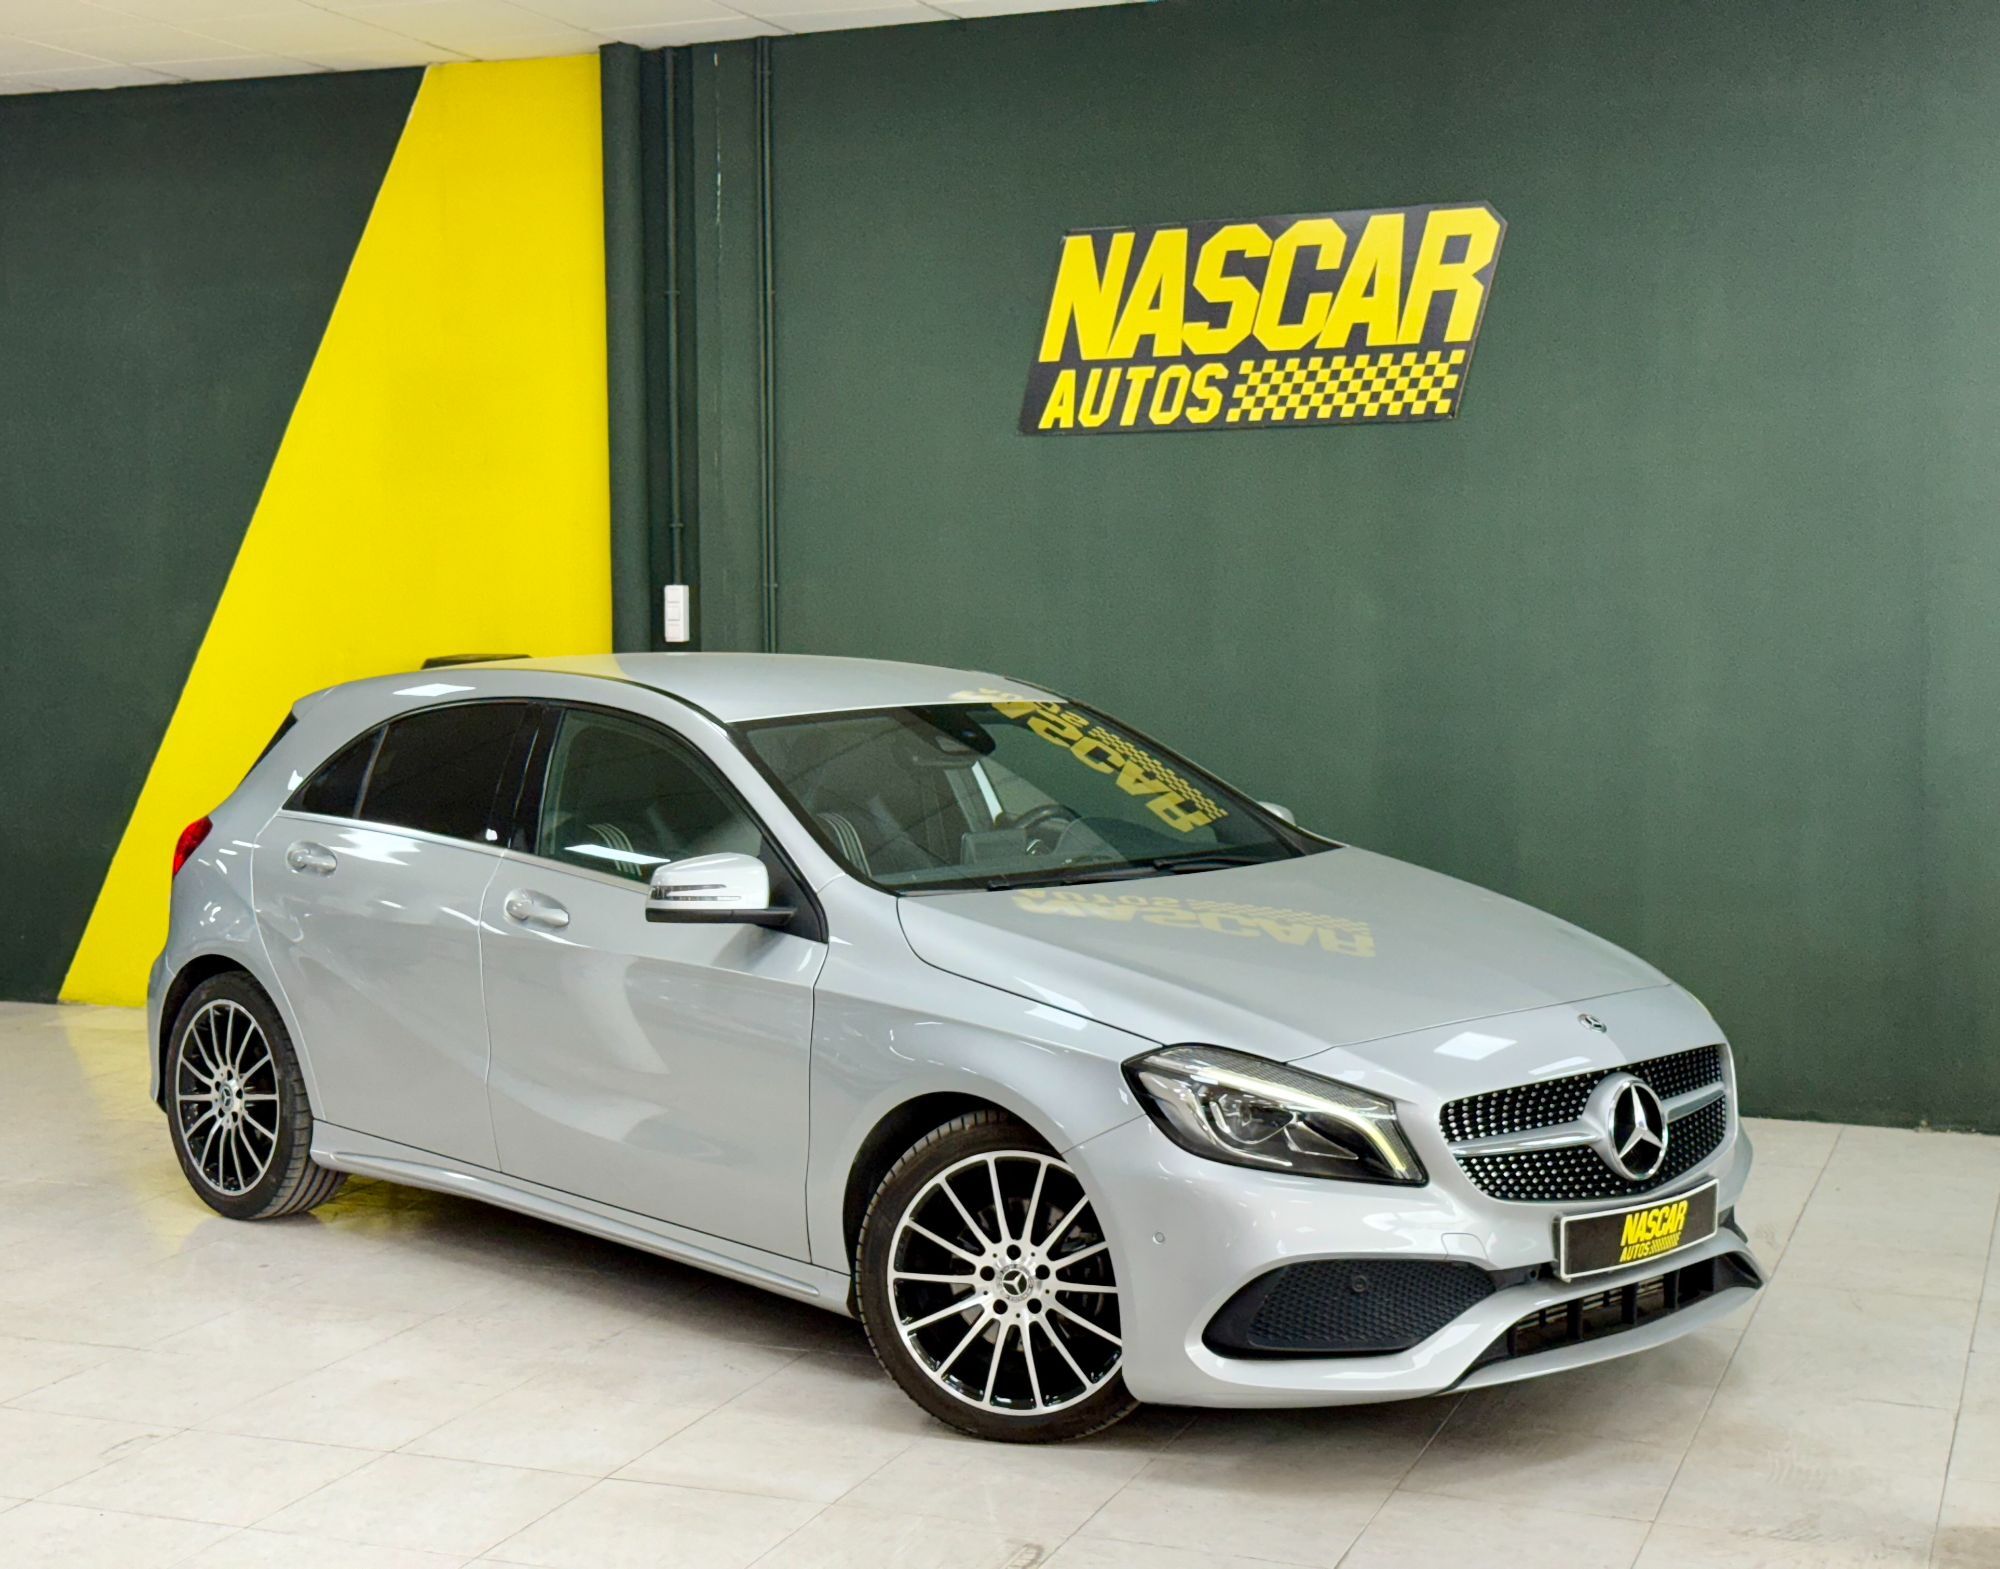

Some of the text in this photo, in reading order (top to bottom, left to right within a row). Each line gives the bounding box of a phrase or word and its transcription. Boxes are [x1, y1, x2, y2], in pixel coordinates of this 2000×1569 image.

[1038, 207, 1500, 363] NASCAR
[1038, 363, 1229, 430] AUTOS
[1620, 1200, 1688, 1246] NASCAR
[1619, 1241, 1651, 1262] AUTOS
